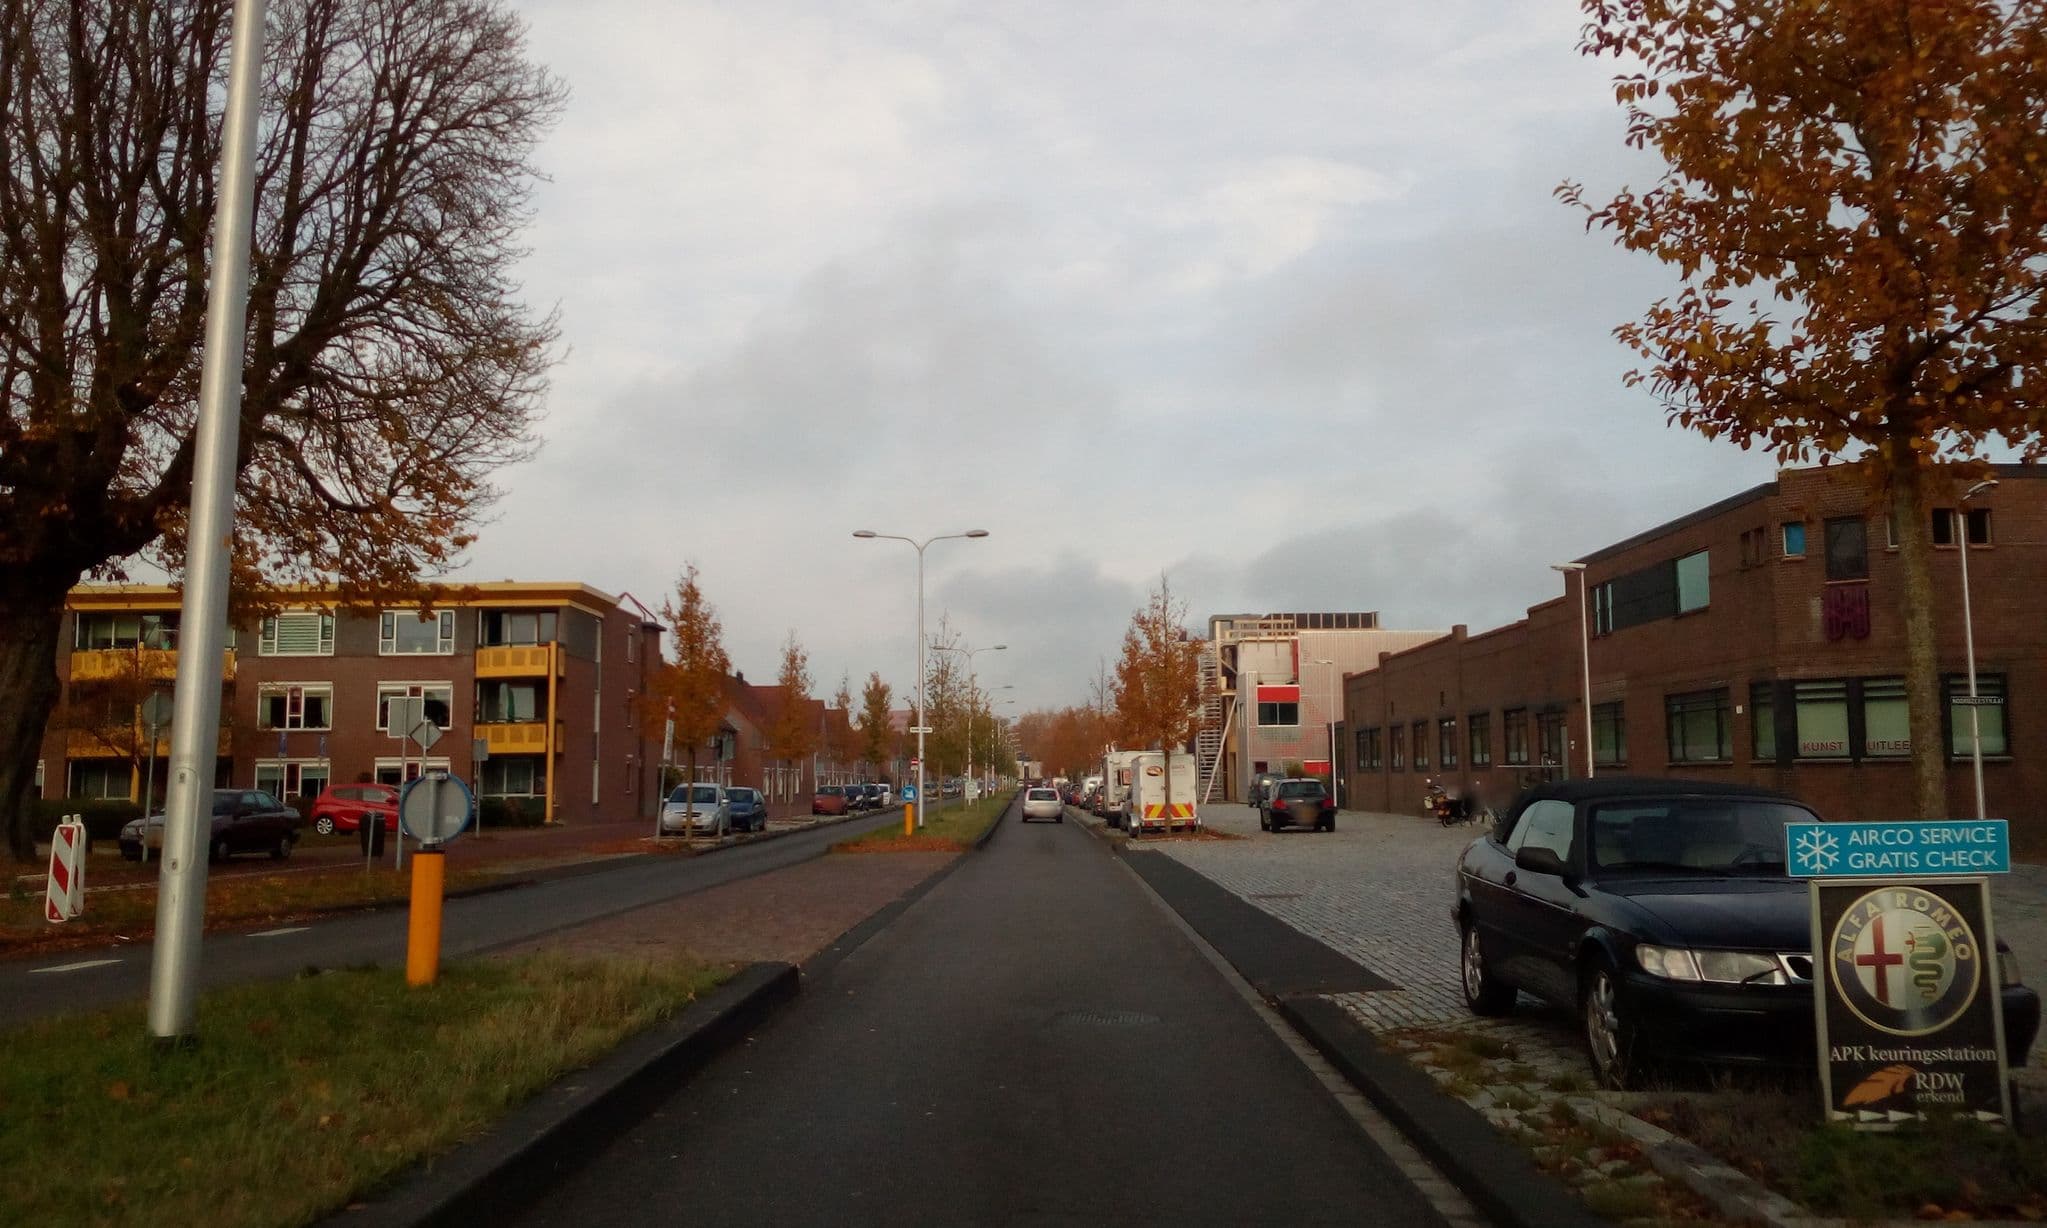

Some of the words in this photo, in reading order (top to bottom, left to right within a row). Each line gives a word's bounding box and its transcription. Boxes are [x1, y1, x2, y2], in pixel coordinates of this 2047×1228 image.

[1803, 742, 1844, 753] KUNST
[1867, 740, 1912, 751] UITLEE
[1848, 828, 1914, 846] AIRCO
[1920, 827, 1997, 845] SERVICE
[1848, 851, 1920, 869] GRATIS
[1926, 850, 1999, 868] CHECK
[1836, 901, 1882, 964] ALFA
[1896, 892, 1972, 962] ROMEO
[1830, 1046, 1865, 1062] APK
[1868, 1044, 1997, 1065] keuringsstation
[1915, 1072, 1965, 1090] RDW
[1916, 1089, 1965, 1103] erkend
